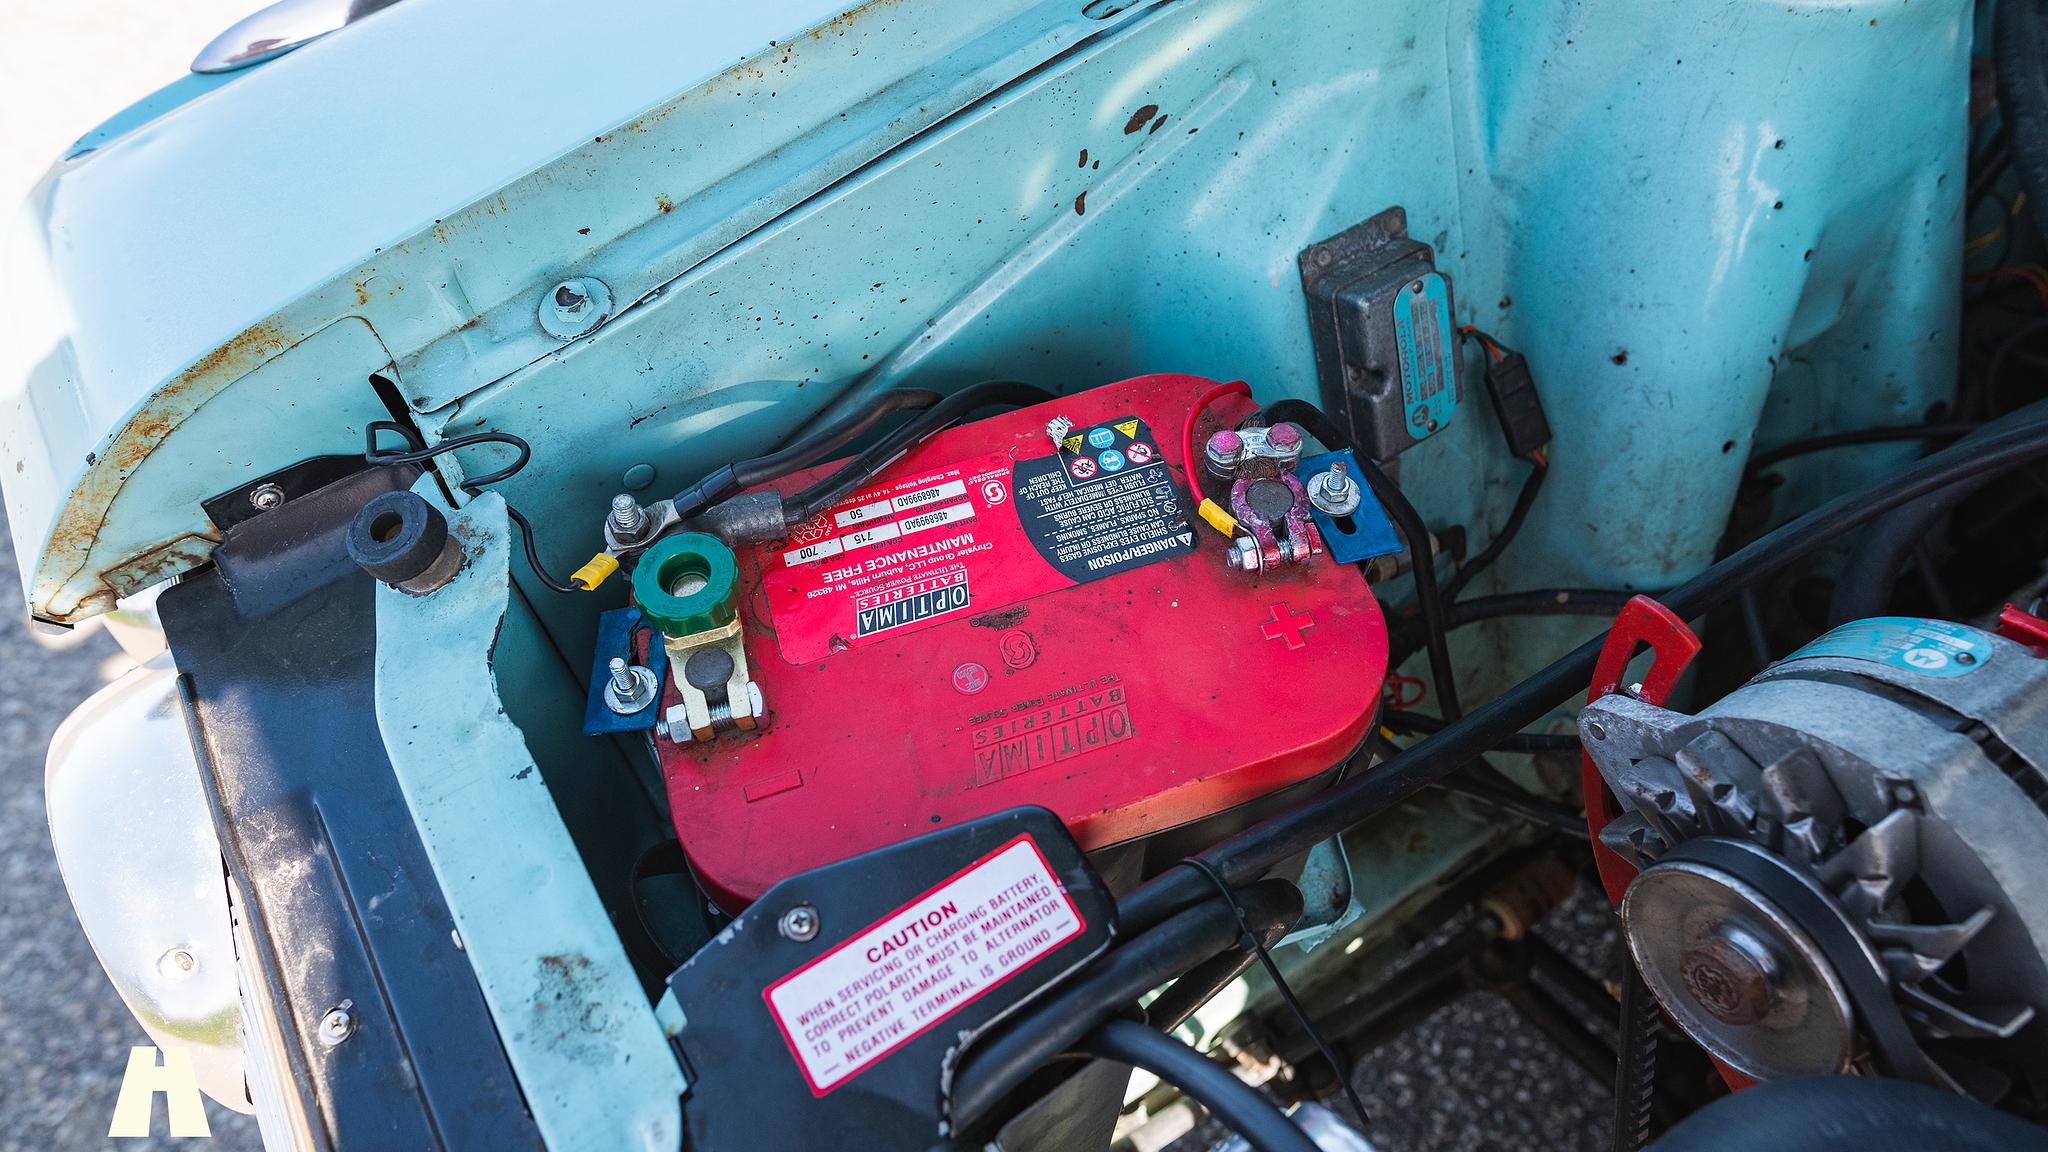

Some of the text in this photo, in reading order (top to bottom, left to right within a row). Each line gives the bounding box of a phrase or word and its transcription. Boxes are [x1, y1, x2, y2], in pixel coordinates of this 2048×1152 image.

[1397, 319, 1413, 402] MOTOROLA
[917, 473, 944, 485] Charging
[944, 469, 960, 477] Max.
[1029, 470, 1060, 484] CHILDREN
[873, 488, 890, 497] 14.4V
[894, 480, 917, 490] Voltage
[1017, 476, 1064, 495] THE REACH OF
[1025, 482, 1066, 500] KEEP OUT OF
[1074, 482, 1103, 496] MEDICAL
[1103, 479, 1117, 488] GET
[897, 488, 939, 505] 4868999AD
[1044, 477, 1145, 511] FLUSH EYES IMMEDIATELY WITH
[1056, 490, 1074, 501] HELP
[849, 508, 862, 519] 50
[1053, 489, 1149, 521] BLINDNESS OR SEVERE BURNS
[1058, 496, 1152, 527] SULFURIC ACID CAN CAUSE
[1148, 507, 1158, 516] NO
[904, 511, 947, 529] 4868999AD
[853, 531, 873, 544] 715
[1055, 527, 1087, 542] SMOKING
[1056, 519, 1164, 555] CAN CAUSE BLINDNESS OR INJURY
[799, 545, 818, 559] 700
[1058, 526, 1167, 563] SHIELD EYES EXPLOSIVE GASES
[1088, 537, 1174, 569] DANGER/POISON
[822, 532, 973, 582] MAINTENANCE FREE
[948, 561, 964, 571] THE
[806, 541, 992, 598] Chrysler Group LLC, Auburn Hills, MI 48326
[913, 566, 947, 580] ULTIMATE
[859, 573, 963, 607] BATTERIES
[885, 575, 911, 589] POWER
[861, 586, 966, 629] OPTIMA
[974, 689, 1121, 743] BATTERIES
[978, 709, 1127, 778] OPTIMA
[865, 901, 958, 964] CAUTION
[797, 998, 835, 1026] WHEN
[837, 957, 902, 1002] SERVICING
[905, 945, 922, 960] OR
[926, 905, 987, 948] CHARGING
[805, 885, 1051, 1042] CORRECT POLARITY MUST BE MAINTAINED
[813, 899, 1060, 1056] TO PREVENT DAMAGE TO ALTERNATOR
[844, 1019, 905, 1062] NEGATIVE
[912, 976, 974, 1020] TERMINAL
[979, 963, 994, 978] IS
[998, 928, 1051, 966] GROUND
